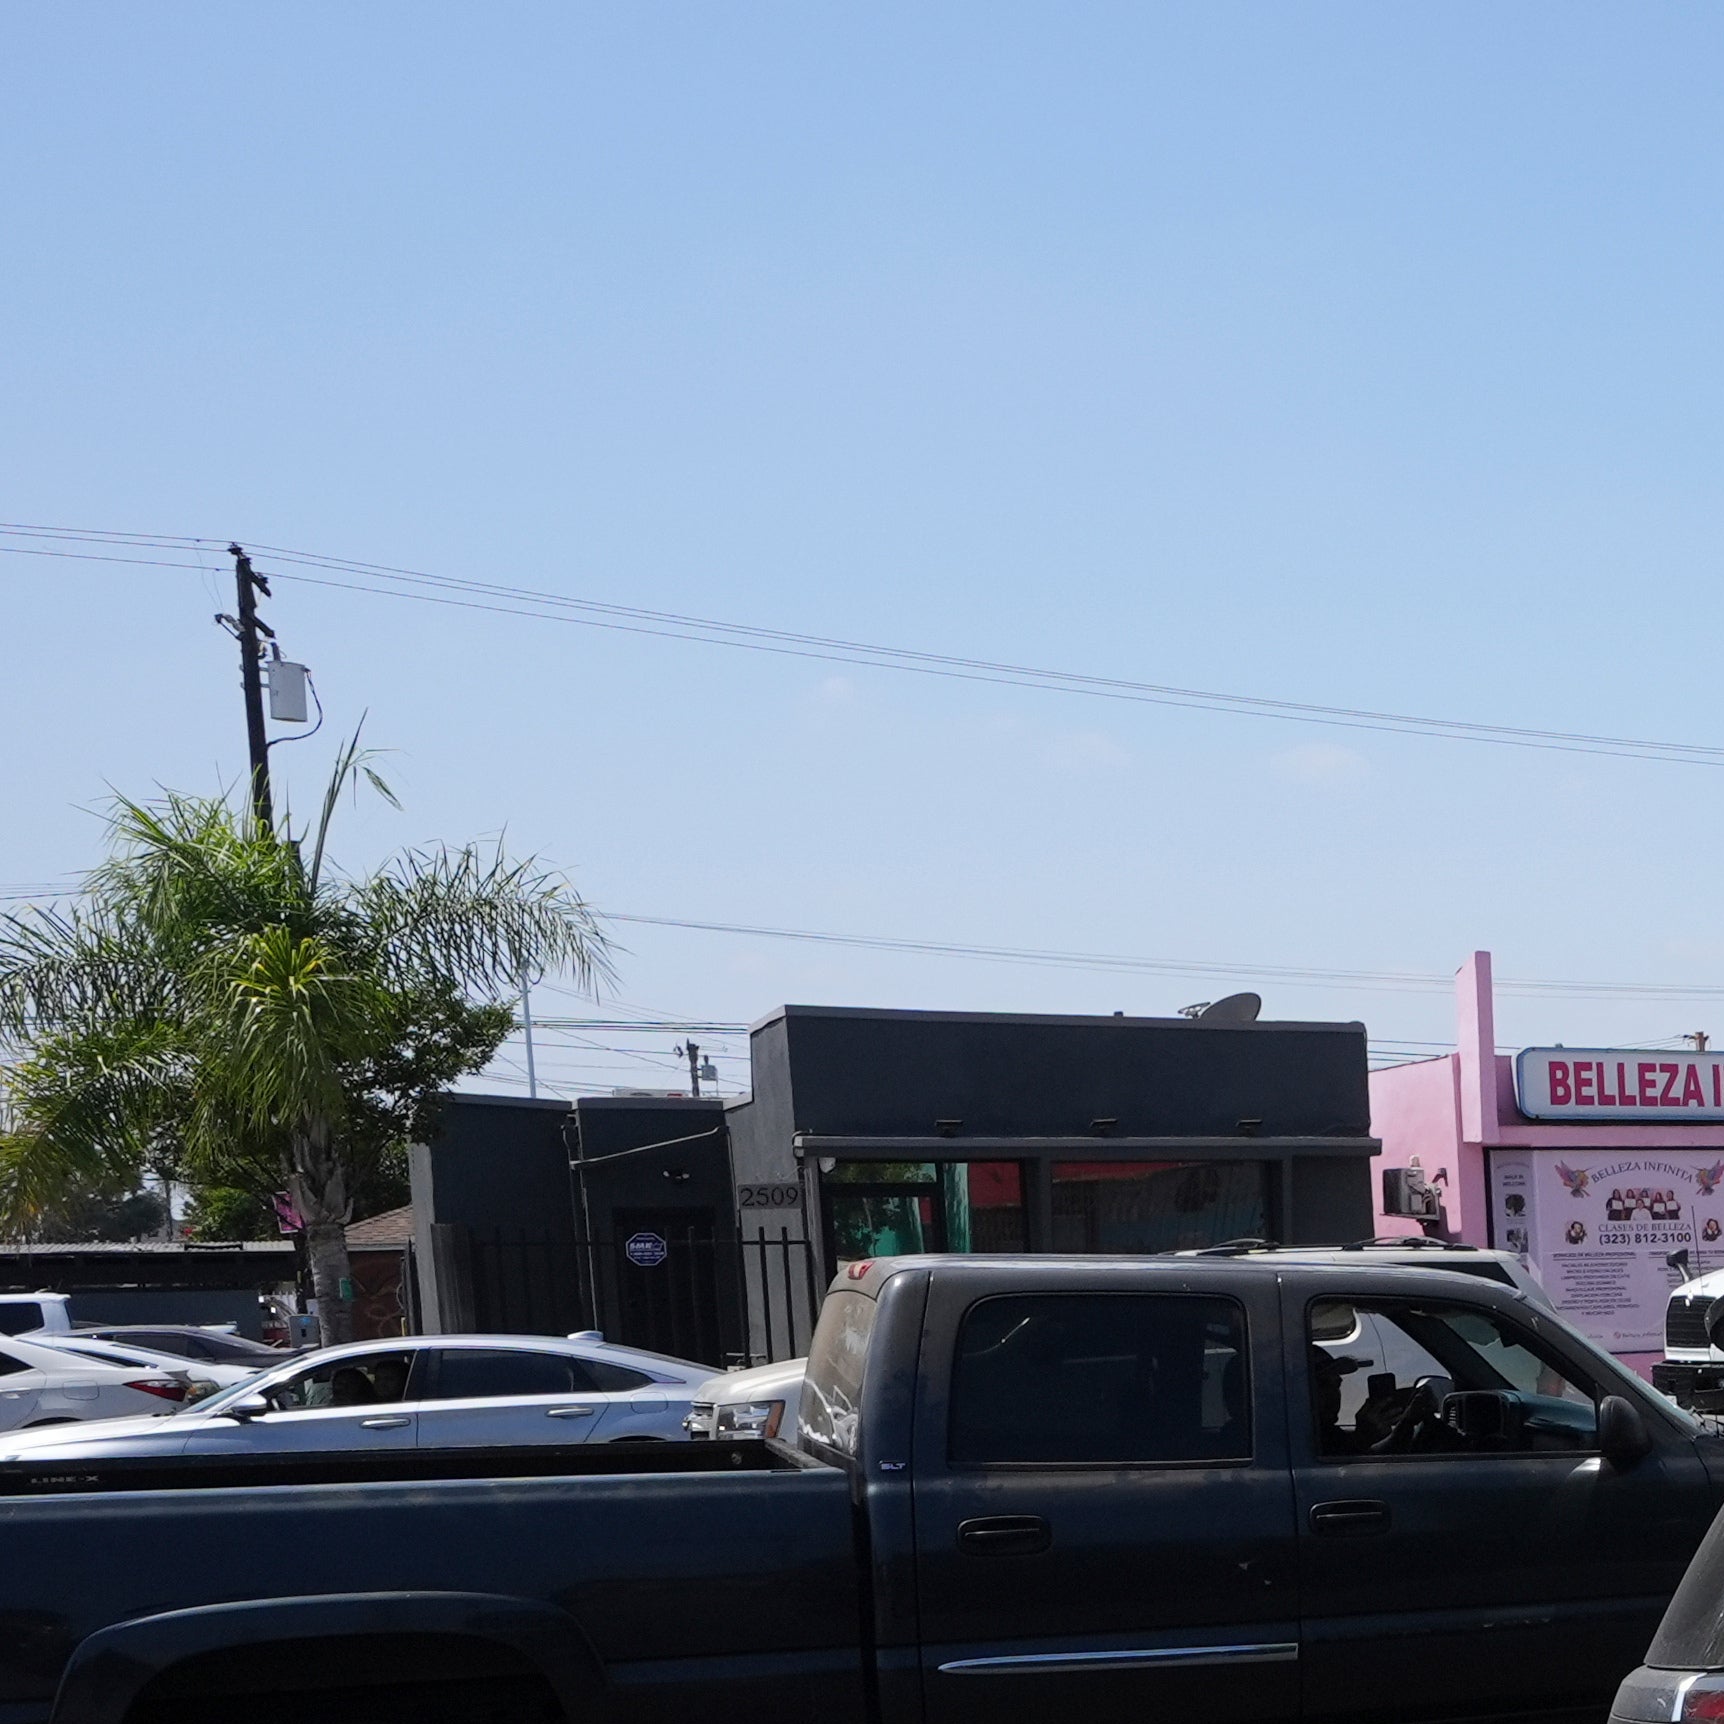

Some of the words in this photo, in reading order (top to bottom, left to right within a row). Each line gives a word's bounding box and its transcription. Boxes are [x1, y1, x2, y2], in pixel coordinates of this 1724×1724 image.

[1548, 1061, 1705, 1108] BELLEZA
[1591, 1161, 1641, 1184] BELLEZA
[1643, 1161, 1694, 1184] INFINITA
[740, 1186, 799, 1207] 2509
[1598, 1223, 1635, 1232] CLASES
[1636, 1223, 1650, 1231] DE
[1651, 1222, 1692, 1231] BELLEZA
[1599, 1233, 1631, 1246] (323)
[1634, 1232, 1692, 1244] 812-3100
